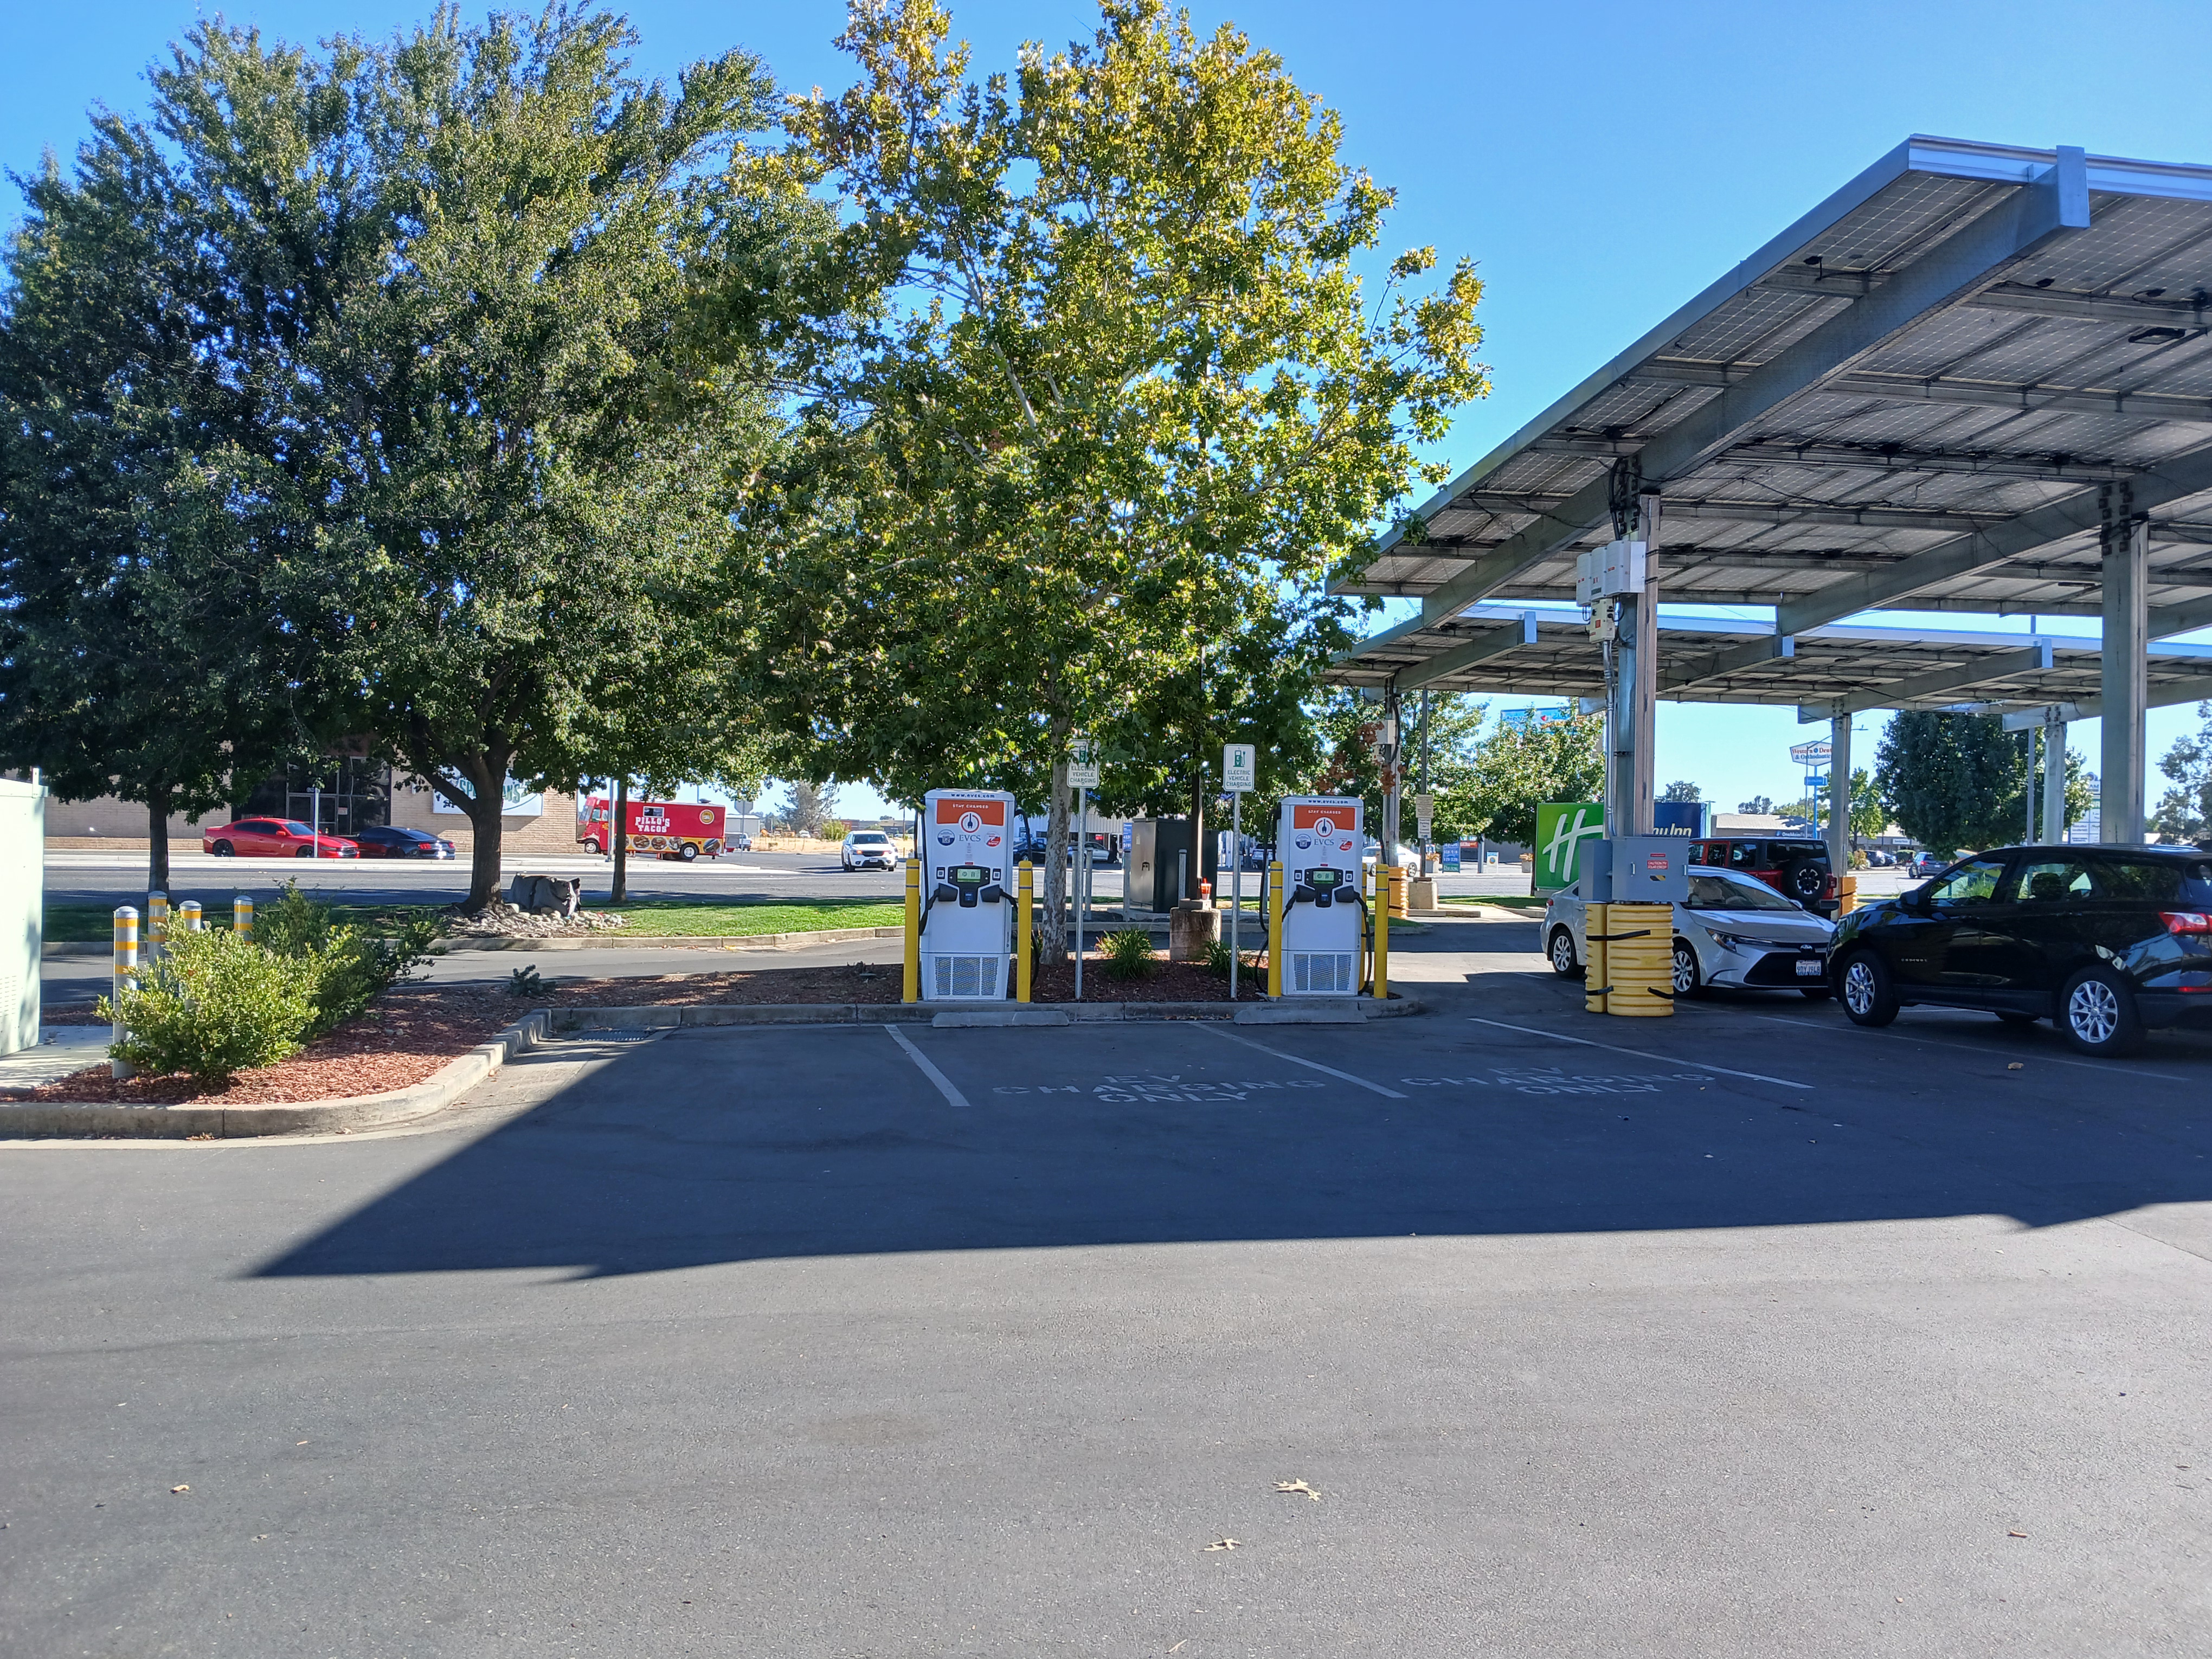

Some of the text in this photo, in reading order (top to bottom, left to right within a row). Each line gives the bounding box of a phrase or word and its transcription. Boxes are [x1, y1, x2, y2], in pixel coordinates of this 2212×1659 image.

[635, 816, 670, 827] PILLO'S
[638, 825, 667, 833] TACOS
[1670, 823, 1692, 837] Inn
[1400, 1073, 1715, 1085] CHARGING
[992, 1081, 1326, 1094] CHARGING
[1516, 1084, 1662, 1095] ONLY
[1097, 1091, 1248, 1102] ONLY
